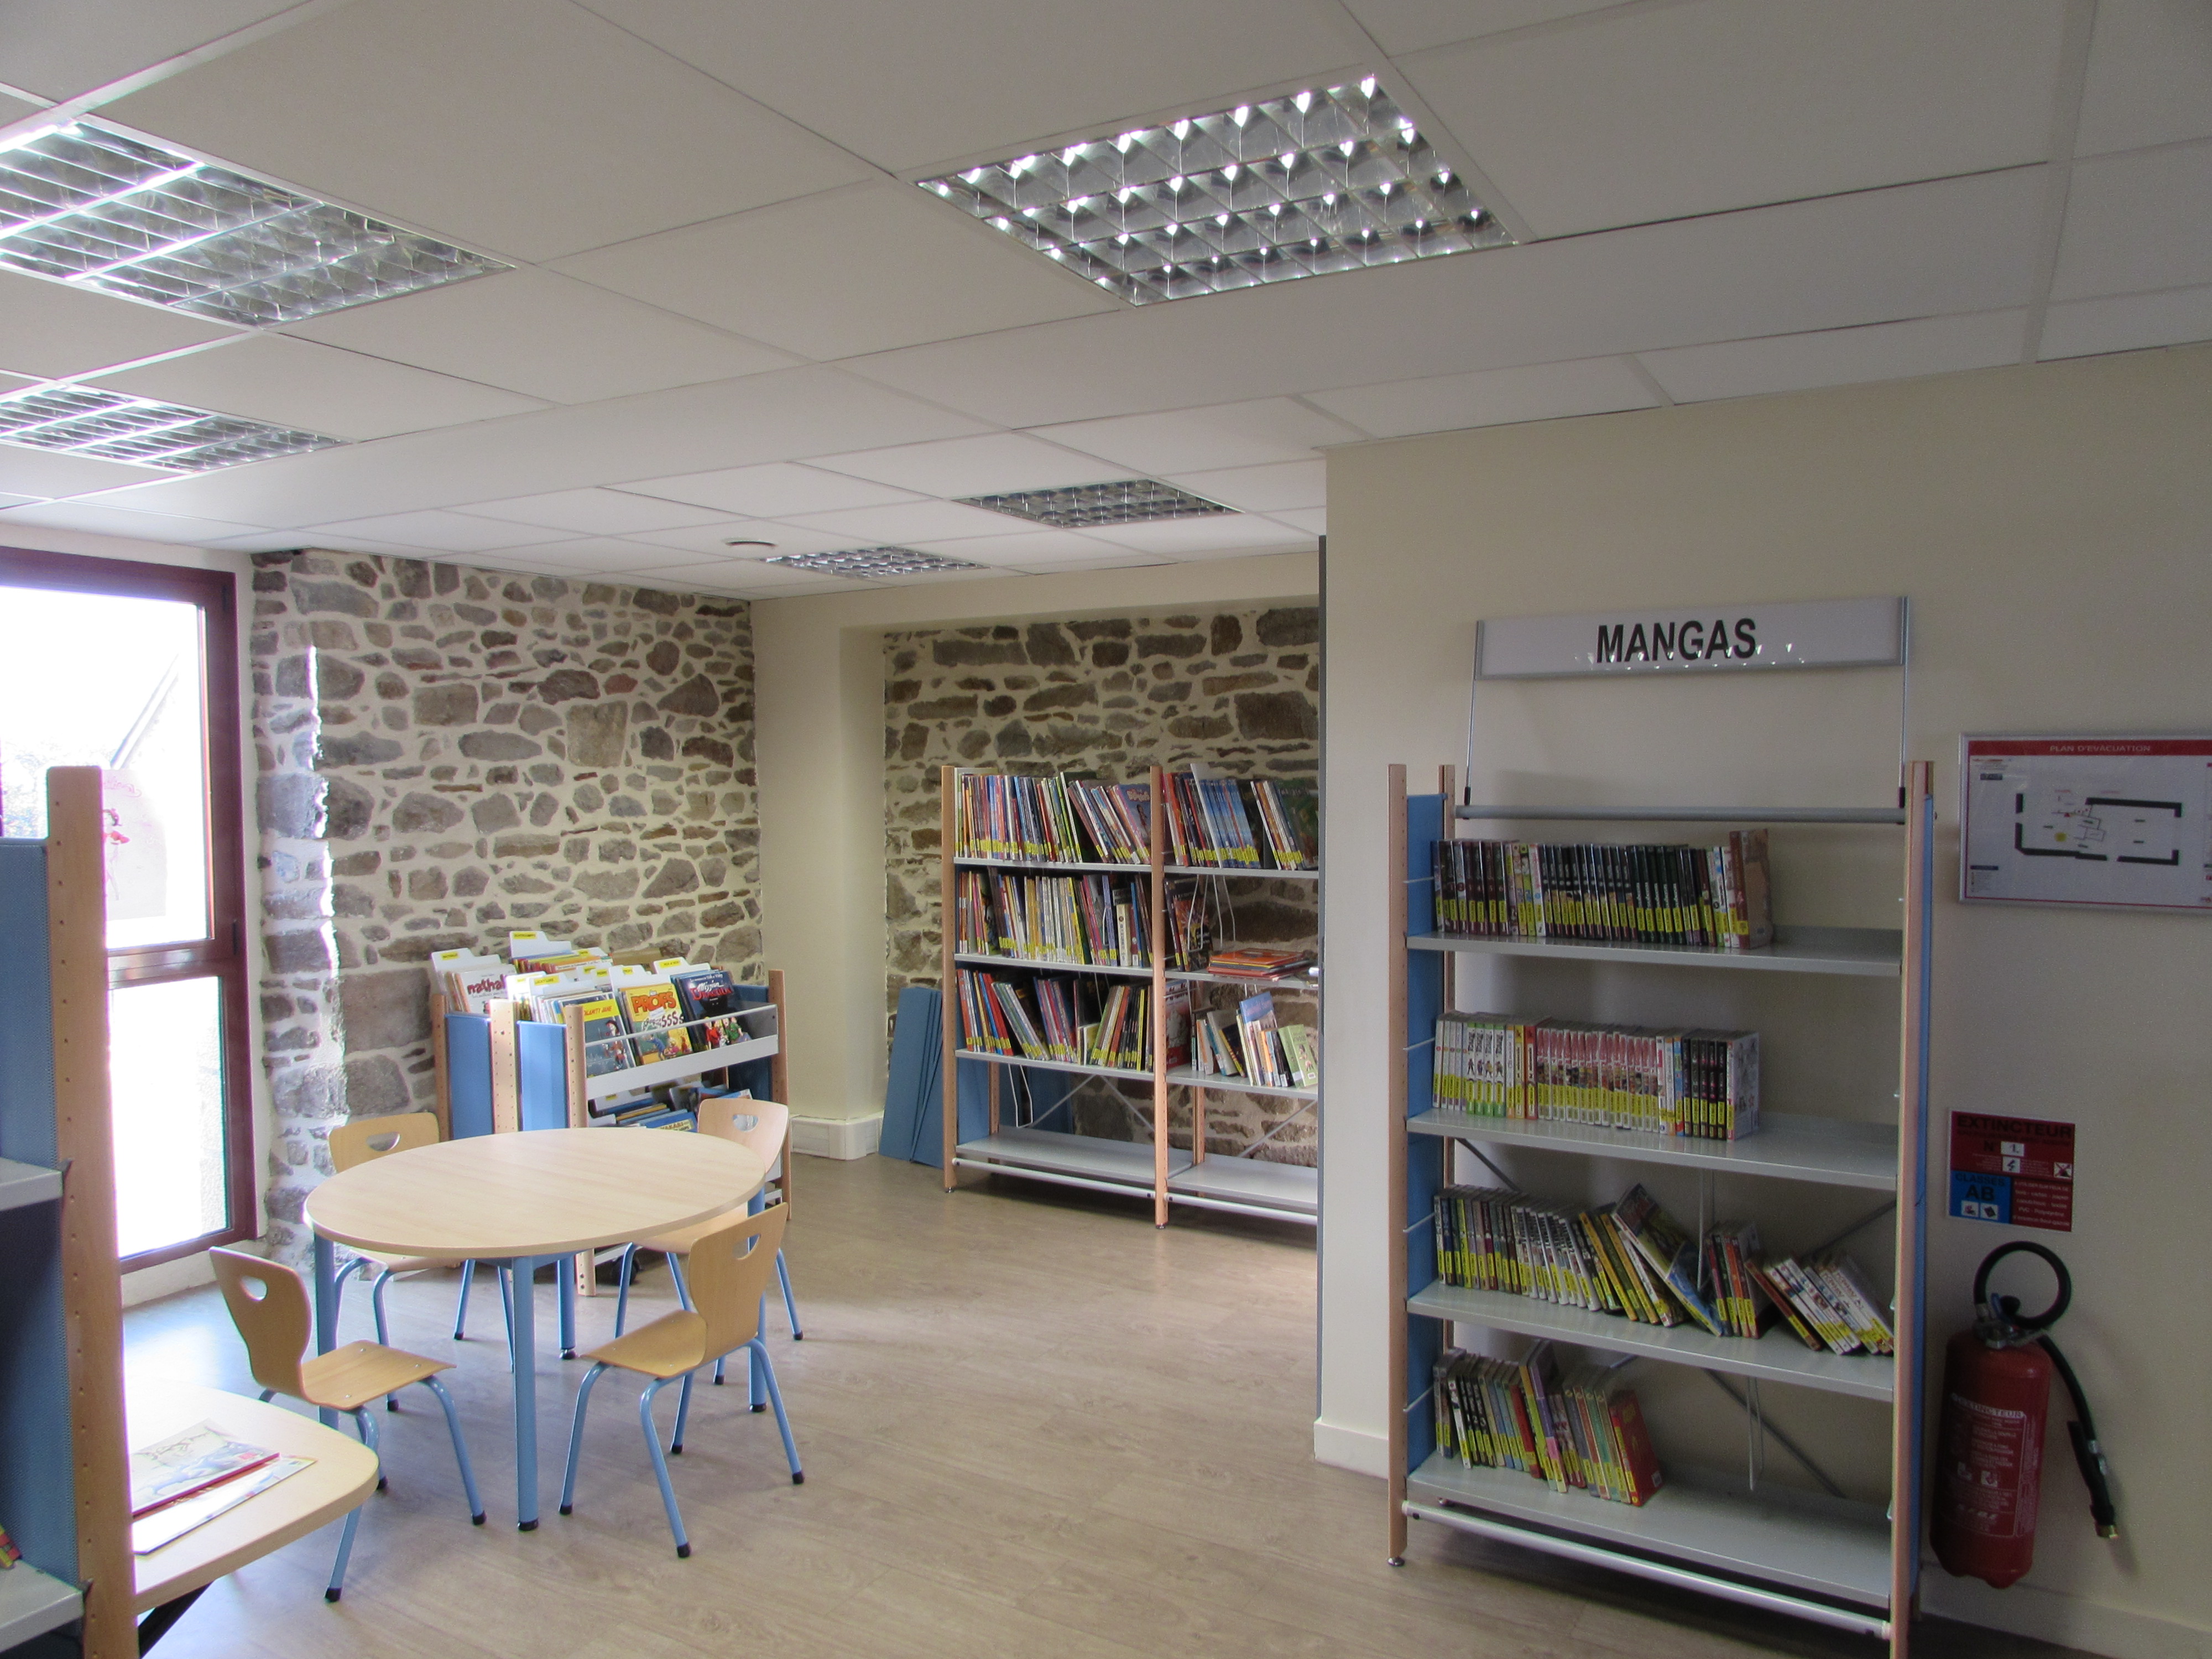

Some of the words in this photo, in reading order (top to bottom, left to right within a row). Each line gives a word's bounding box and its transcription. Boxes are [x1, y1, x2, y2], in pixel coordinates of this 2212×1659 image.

[1597, 618, 1757, 664] MANGAS
[630, 992, 676, 1014] PROFS
[1957, 1115, 2072, 1138] EXTINCTEUR
[1955, 1172, 2006, 1187] CLASSES
[1965, 1185, 1995, 1201] AB
[1472, 1415, 1478, 1424] 2
[1480, 1417, 1487, 1427] 3
